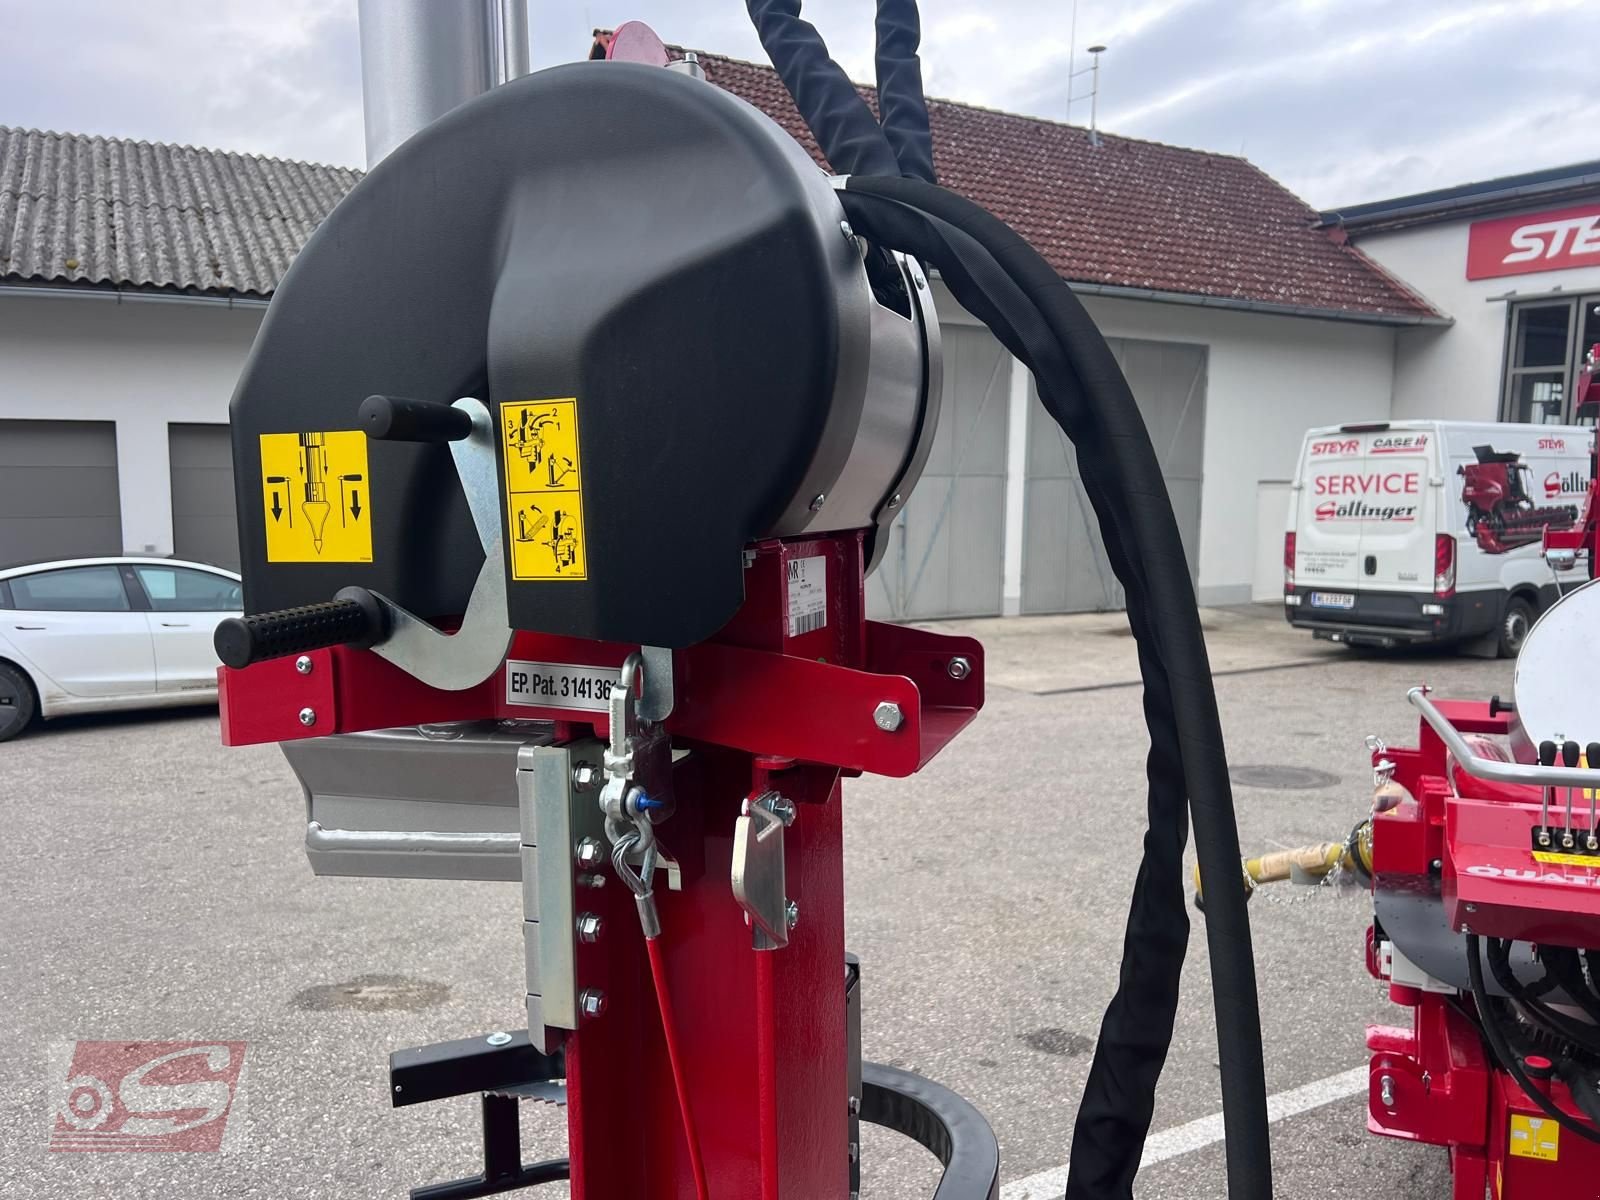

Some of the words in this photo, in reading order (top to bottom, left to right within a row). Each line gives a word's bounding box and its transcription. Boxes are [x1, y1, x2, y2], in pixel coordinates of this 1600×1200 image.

[552, 408, 557, 416] 2
[508, 420, 513, 429] 3
[556, 422, 560, 431] 1
[1311, 439, 1360, 455] STEYR
[1373, 438, 1411, 448] CASE
[1538, 439, 1564, 449] STEYR
[1315, 473, 1419, 495] SERVICE
[1315, 501, 1416, 520] Söllinger
[556, 565, 561, 573] 4
[511, 671, 529, 694] EP.
[533, 673, 557, 696] Pat.
[561, 676, 569, 697] 3
[595, 680, 617, 700] 36
[1466, 866, 1600, 885] QUAT
